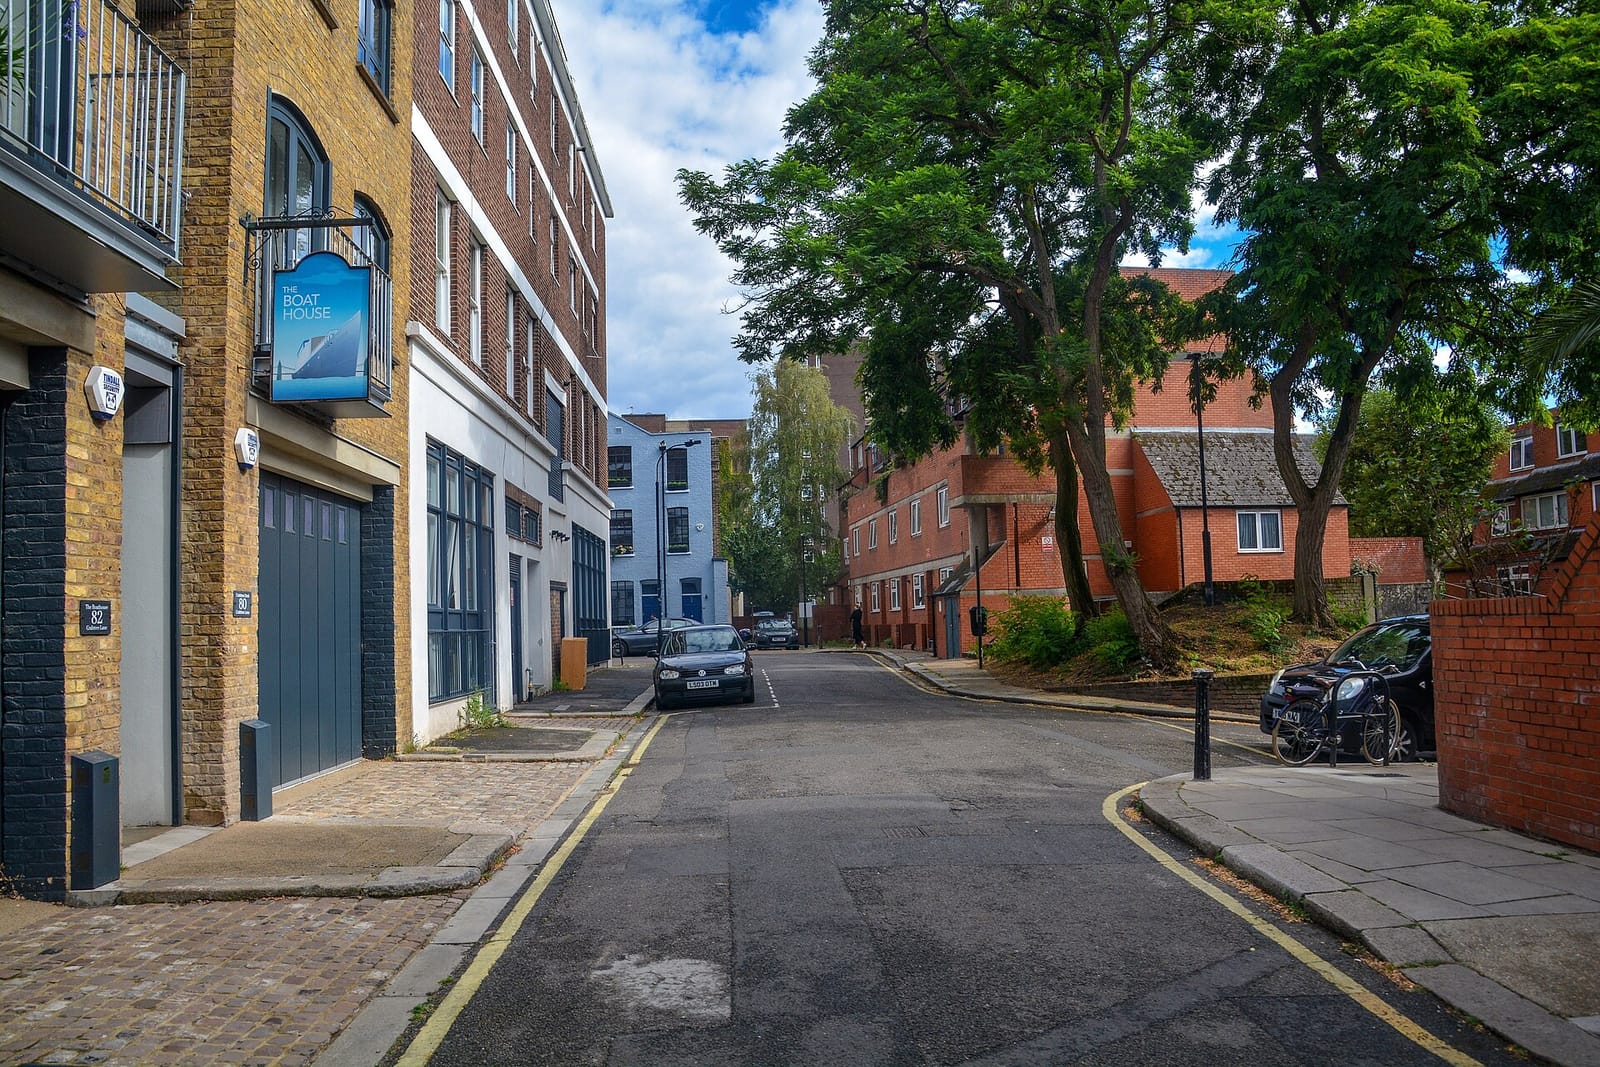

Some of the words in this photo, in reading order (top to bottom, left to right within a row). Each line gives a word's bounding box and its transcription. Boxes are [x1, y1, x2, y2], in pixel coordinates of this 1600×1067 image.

[283, 294, 320, 307] BOAT
[283, 307, 331, 320] HOUSE
[238, 597, 247, 610] 80
[91, 610, 103, 624] 82
